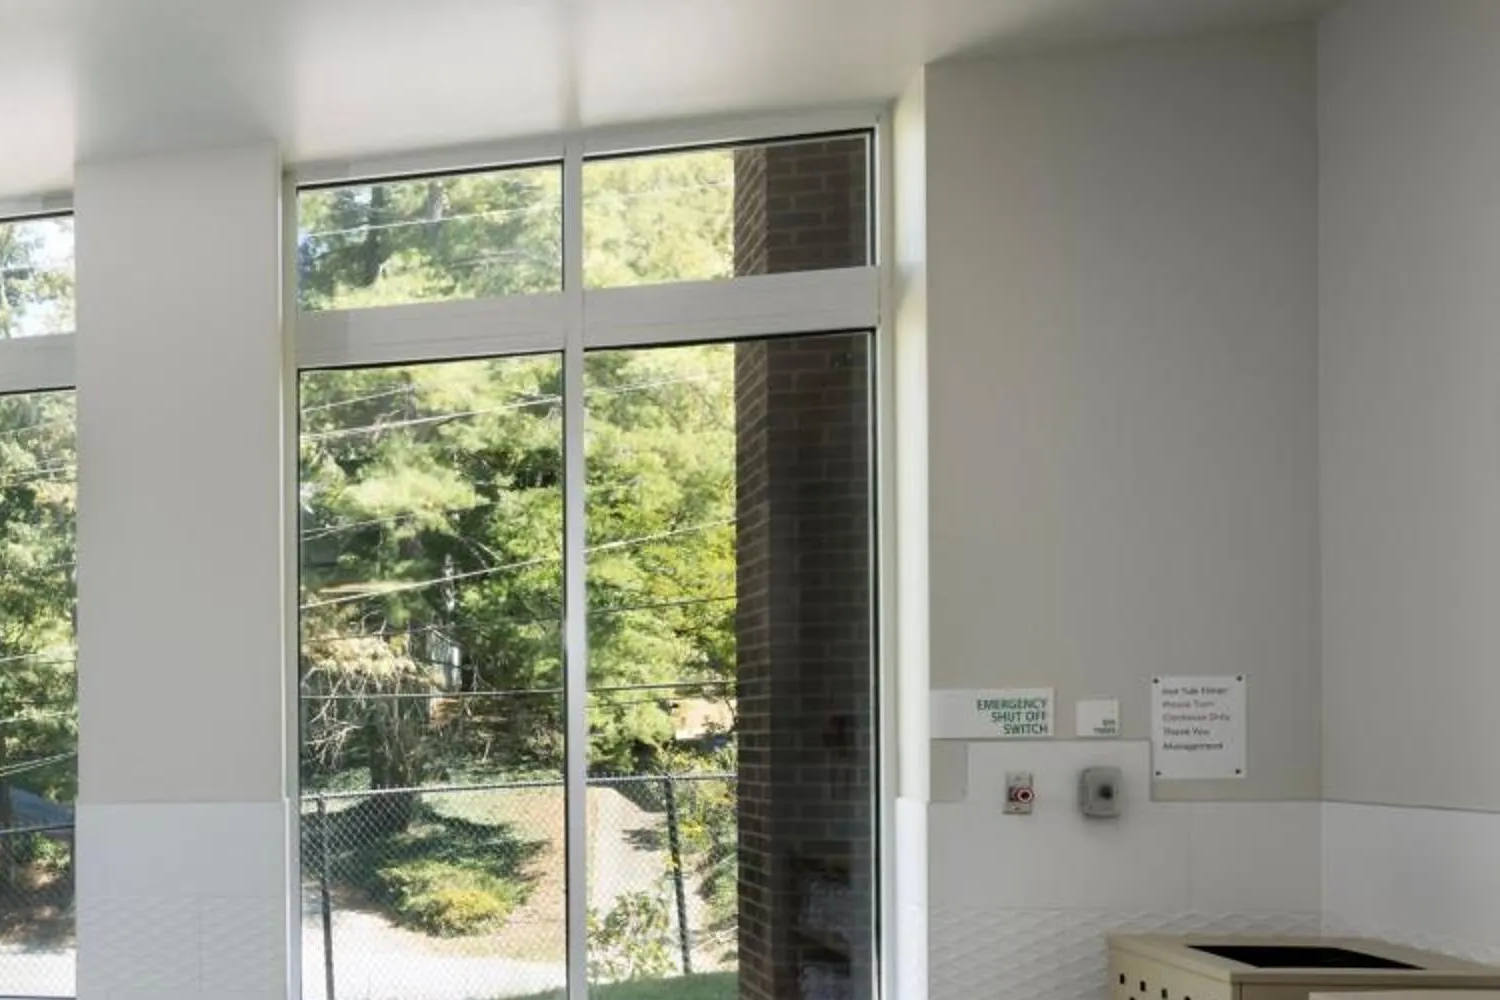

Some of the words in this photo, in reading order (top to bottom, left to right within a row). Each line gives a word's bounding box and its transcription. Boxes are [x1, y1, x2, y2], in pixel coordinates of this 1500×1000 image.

[977, 698, 1046, 710] EMERGENCY
[991, 711, 1021, 723] SHUT
[1025, 711, 1045, 722] OFF
[1004, 723, 1049, 734] SWITCH
